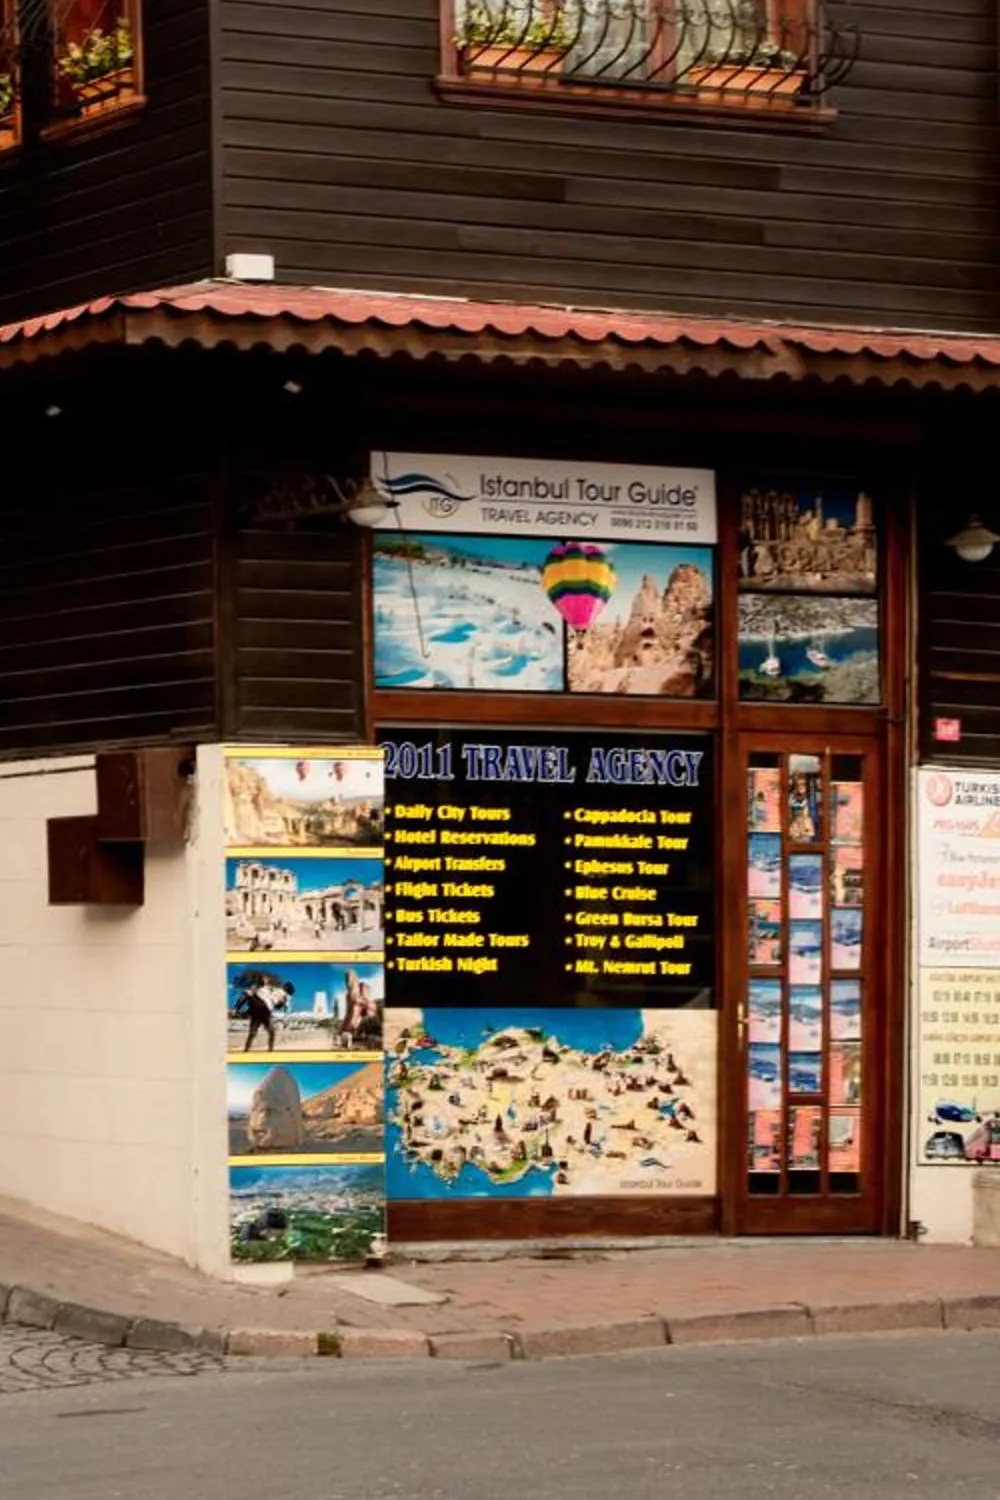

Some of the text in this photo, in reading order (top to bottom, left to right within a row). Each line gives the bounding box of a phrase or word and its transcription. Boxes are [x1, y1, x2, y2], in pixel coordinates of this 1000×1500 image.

[480, 474, 697, 506] Istanbul Tour Guide
[481, 507, 530, 524] TRAVEL
[535, 511, 600, 527] AGENCY
[382, 741, 704, 787] 2011 TRAVEL AGENCY
[394, 803, 511, 822] Daily City Tours
[573, 807, 693, 825] Cappadocia Tour
[394, 829, 537, 846] Hotel Reservations
[574, 833, 689, 850] Pamukkale Tour
[394, 855, 506, 873] Airport Transfers
[574, 859, 669, 876] Ephesus Tour
[394, 881, 495, 900] Flight Tickets
[574, 885, 657, 901] Blue Cruise
[395, 908, 481, 924] Bus Tickets
[575, 911, 699, 927] Green Bursa Tour
[396, 931, 530, 948] Tailor Made Tours
[574, 933, 685, 951] Troy & Gallipoli
[396, 956, 453, 972] Turkish
[456, 957, 498, 975] Night
[603, 959, 657, 975] Nemrut
[659, 961, 692, 976] Tour
